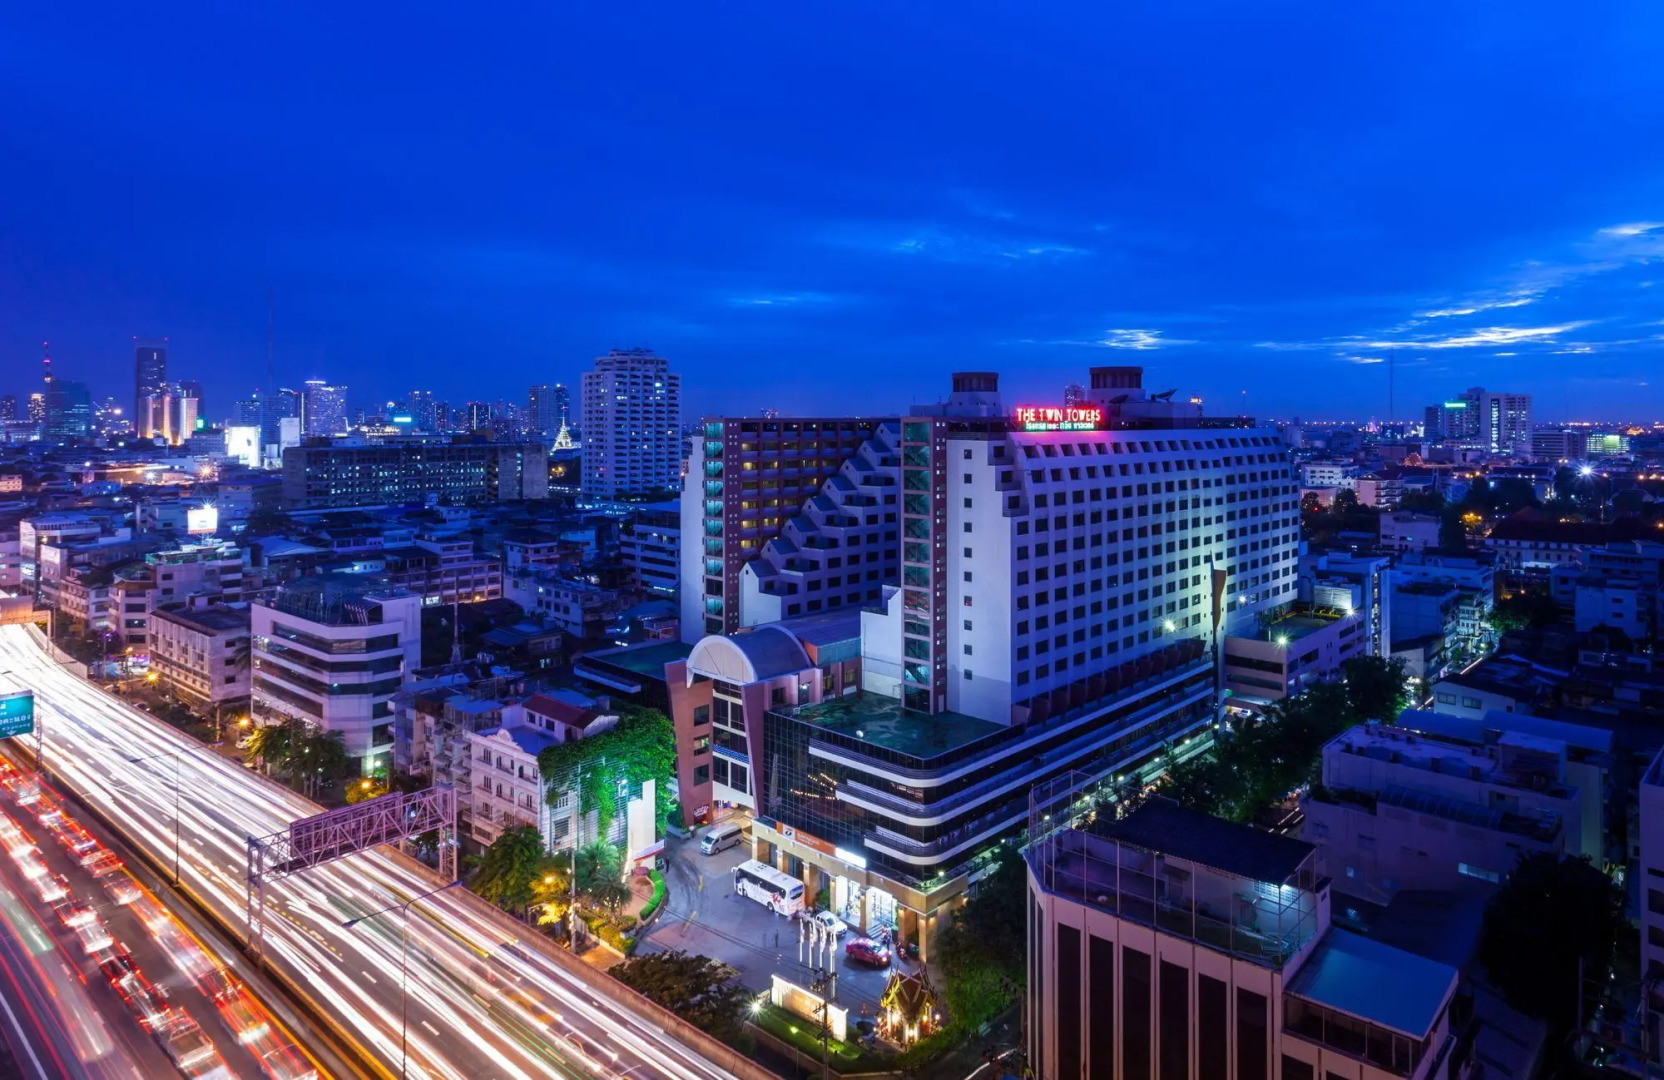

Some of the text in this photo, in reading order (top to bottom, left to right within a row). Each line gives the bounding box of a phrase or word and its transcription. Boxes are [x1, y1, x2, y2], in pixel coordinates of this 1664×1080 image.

[1017, 408, 1100, 421] THE TWIN TOWERS
